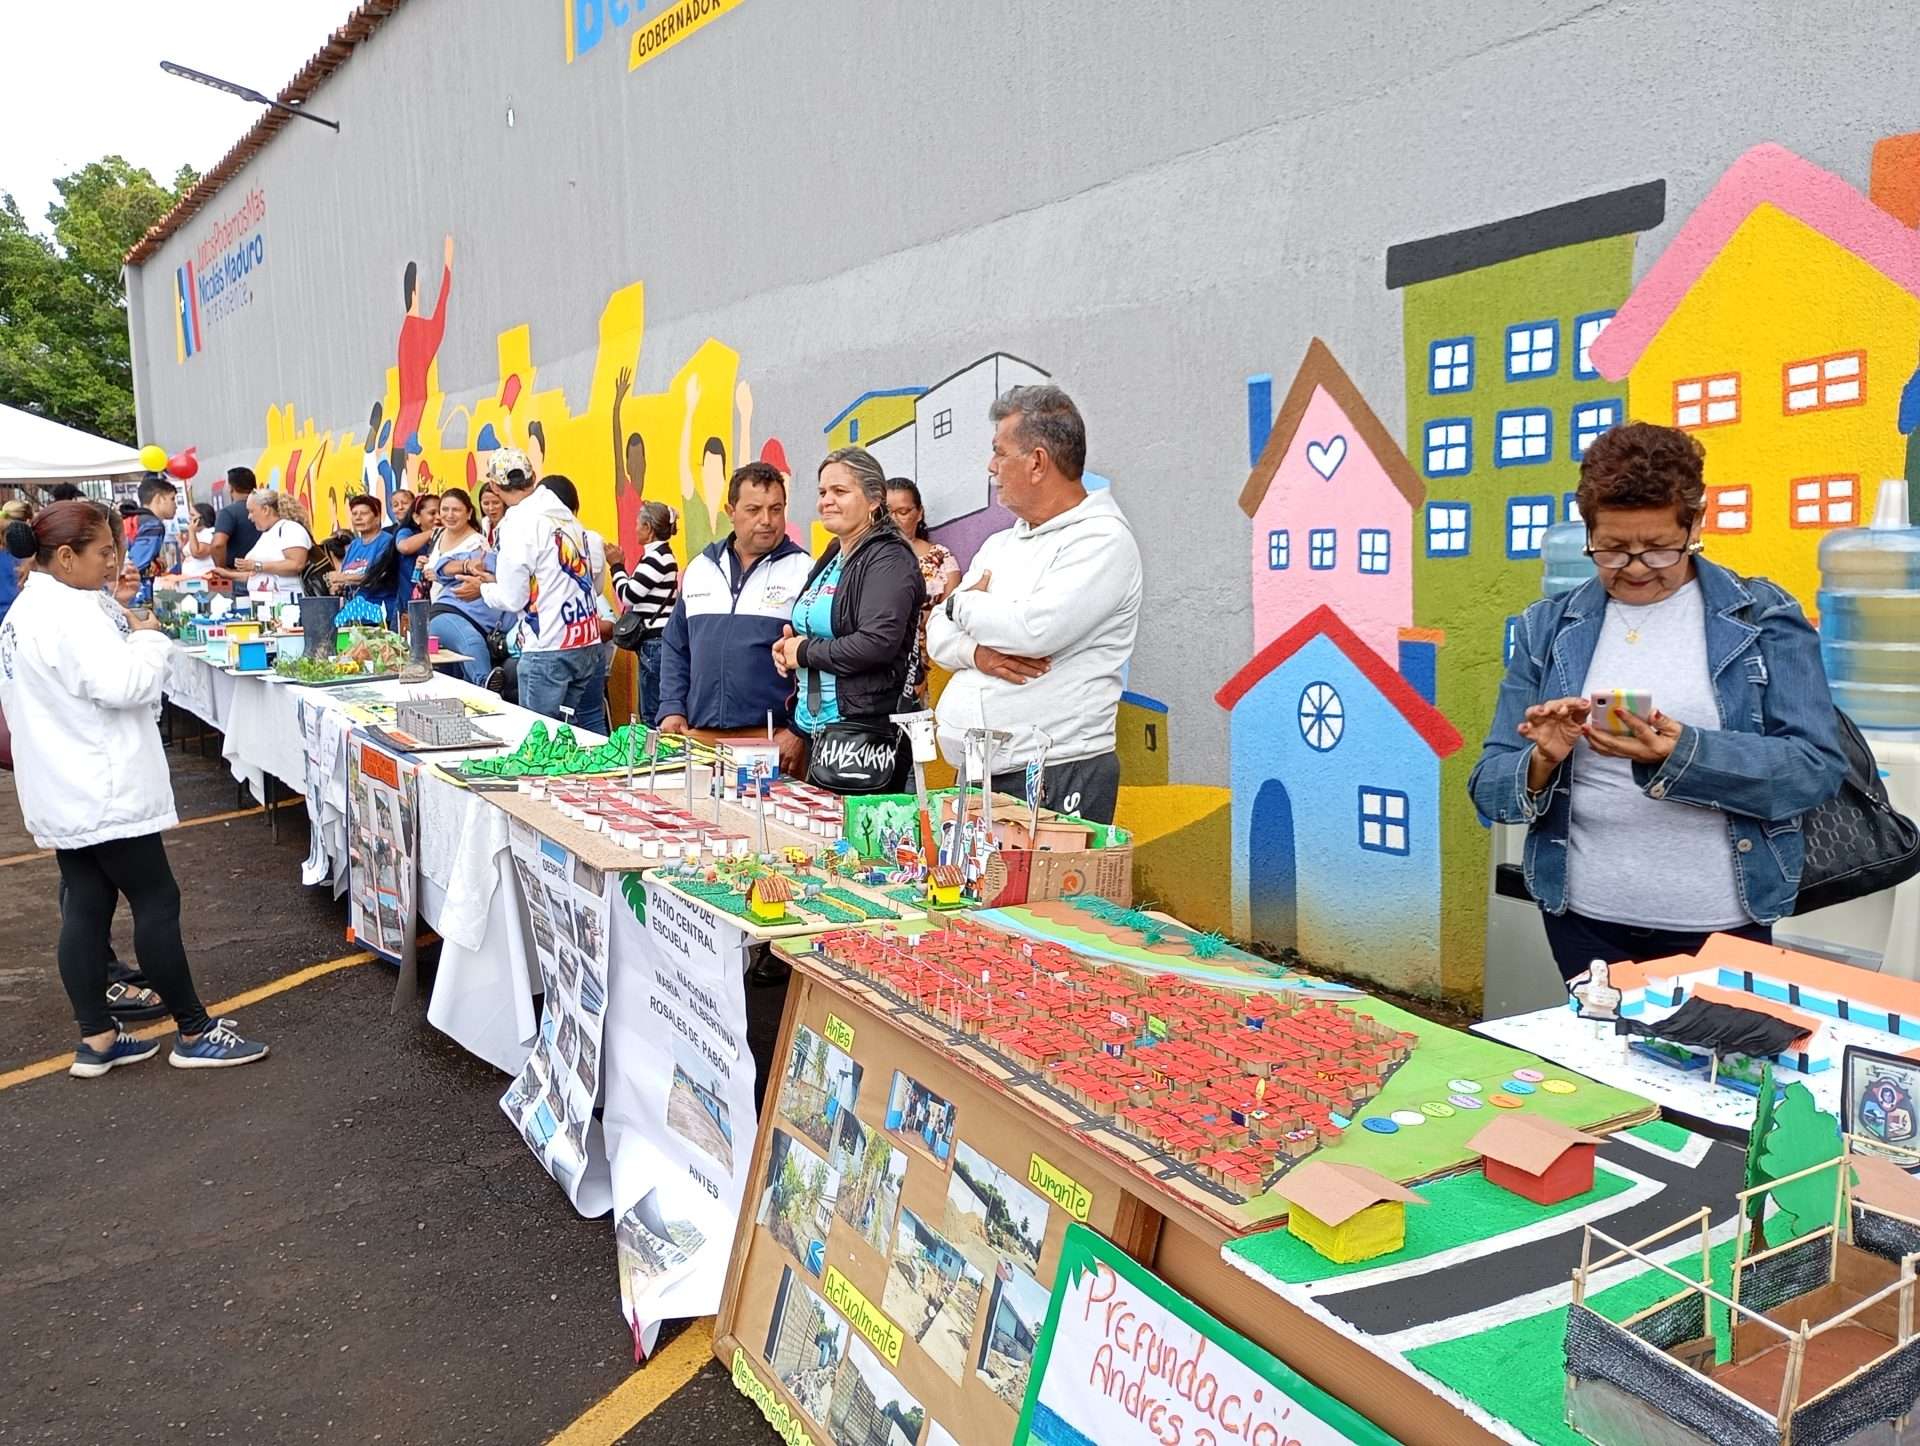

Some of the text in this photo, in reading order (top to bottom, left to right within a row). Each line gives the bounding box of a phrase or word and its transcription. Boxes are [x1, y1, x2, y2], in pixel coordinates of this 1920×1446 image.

[224, 233, 264, 286] Maduro
[652, 892, 675, 921] PATIO
[676, 912, 717, 954] CENTRAL
[652, 917, 690, 957] ESCUELA
[650, 995, 687, 1036] ROSALES
[688, 1027, 699, 1048] DE
[689, 997, 736, 1051] ALBERTINA
[826, 1015, 850, 1048] Antes
[689, 1163, 719, 1199] ANTES
[1031, 1160, 1087, 1219] Durante
[825, 1273, 898, 1359] Actualmente
